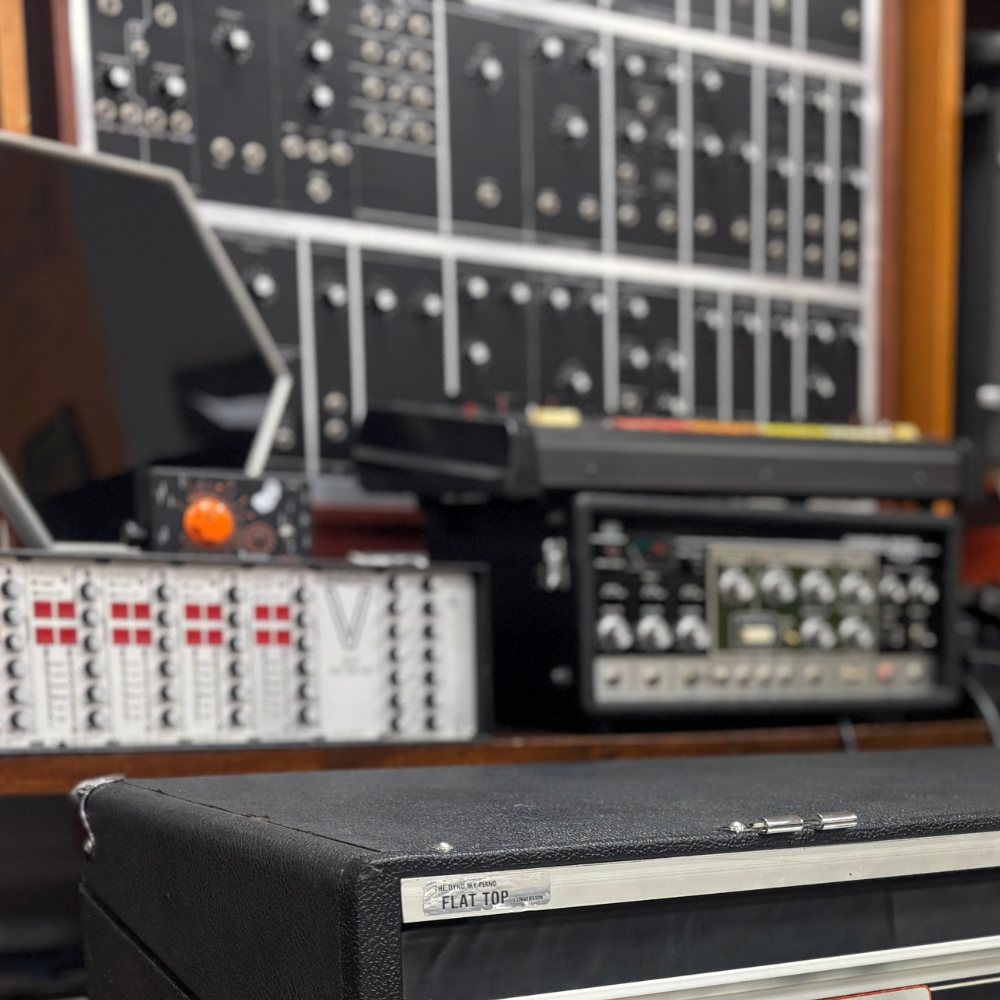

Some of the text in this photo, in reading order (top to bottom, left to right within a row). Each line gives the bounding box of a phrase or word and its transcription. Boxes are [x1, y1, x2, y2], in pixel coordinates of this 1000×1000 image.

[478, 880, 497, 888] PIANO
[442, 890, 509, 910] FLAT TOP
